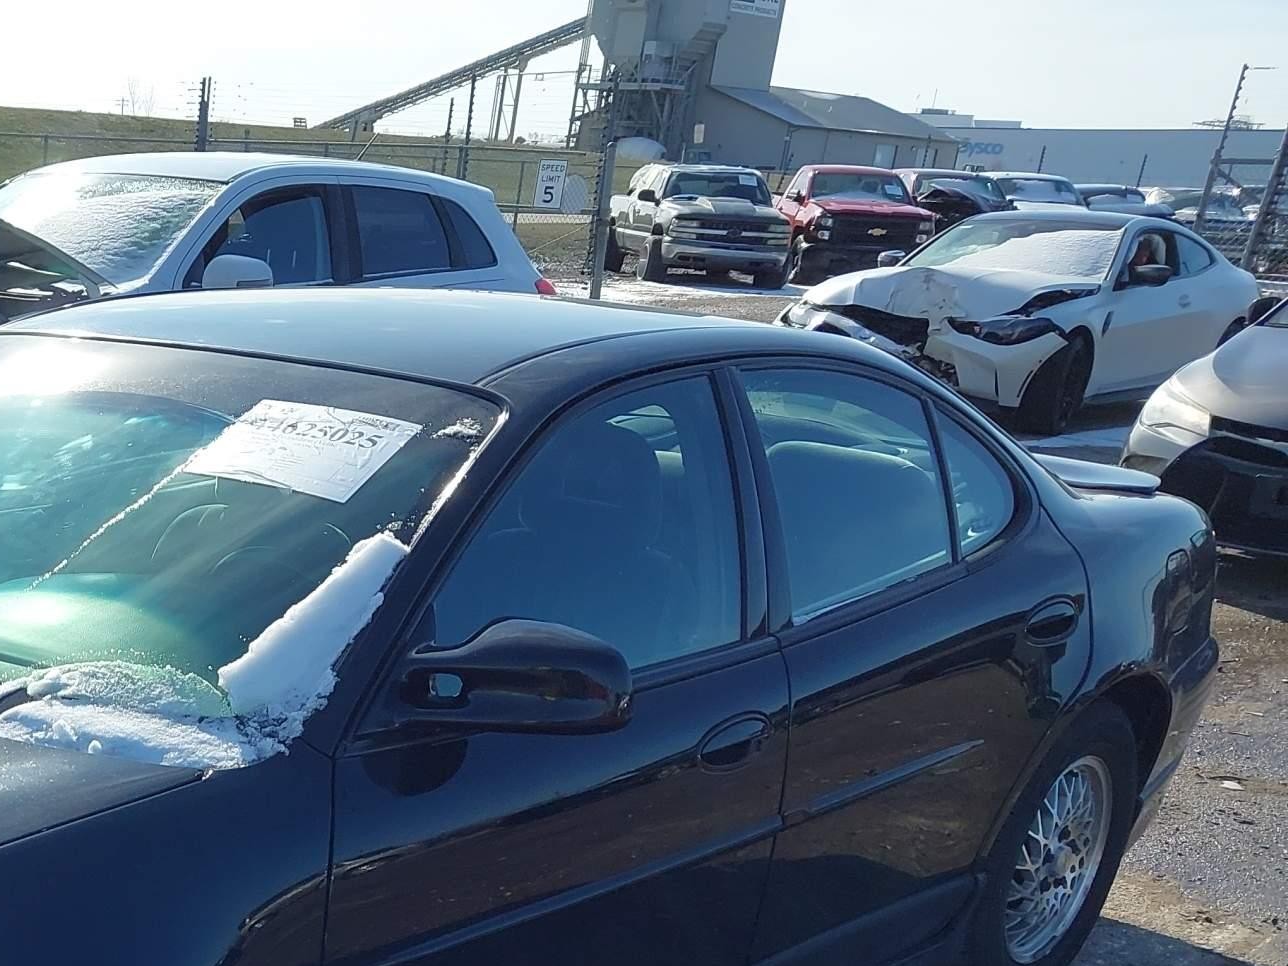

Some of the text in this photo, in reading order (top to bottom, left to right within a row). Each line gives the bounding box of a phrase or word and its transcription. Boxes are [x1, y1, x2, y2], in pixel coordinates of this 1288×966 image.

[541, 164, 565, 172] SPEED
[541, 175, 561, 183] LIMIT
[542, 185, 555, 203] 5
